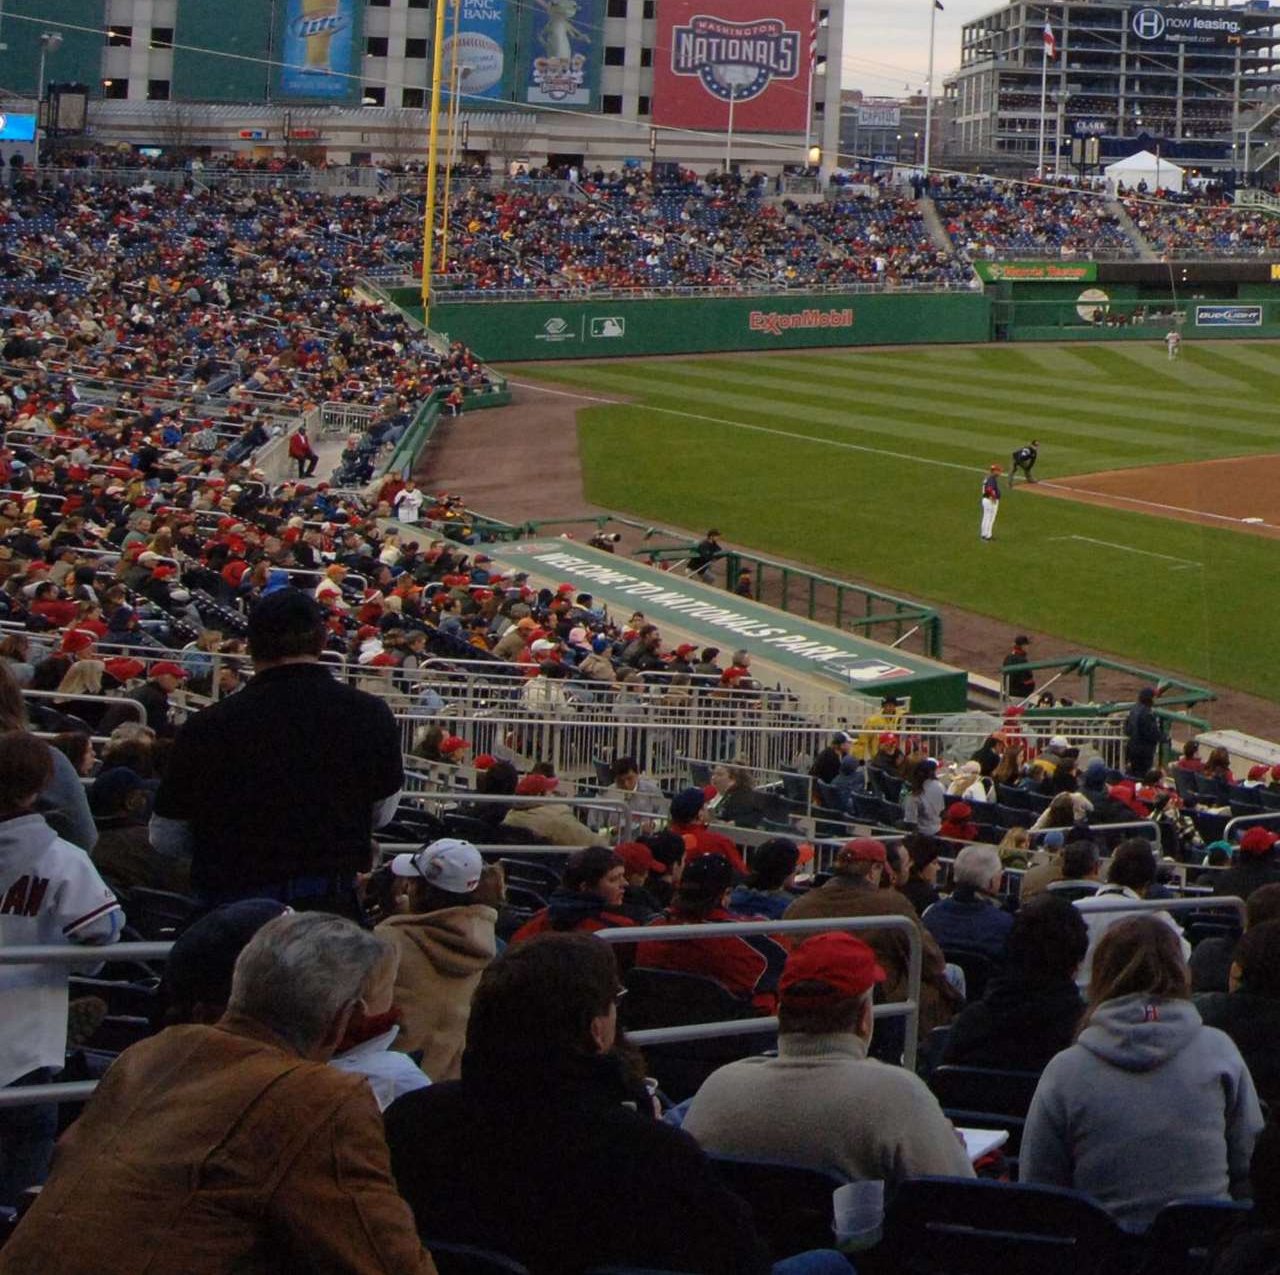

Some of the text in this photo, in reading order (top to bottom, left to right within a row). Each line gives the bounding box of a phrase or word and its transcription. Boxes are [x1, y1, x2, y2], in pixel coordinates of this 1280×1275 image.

[463, 9, 501, 21] BANK
[1166, 18, 1192, 28] now
[1193, 16, 1241, 33] leasing.
[697, 21, 776, 36] WASHINGTON
[680, 33, 793, 71] NATIONALS
[749, 309, 852, 335] ExxonMobil
[533, 551, 859, 662] WELCOME TO NATIONALS PARK
